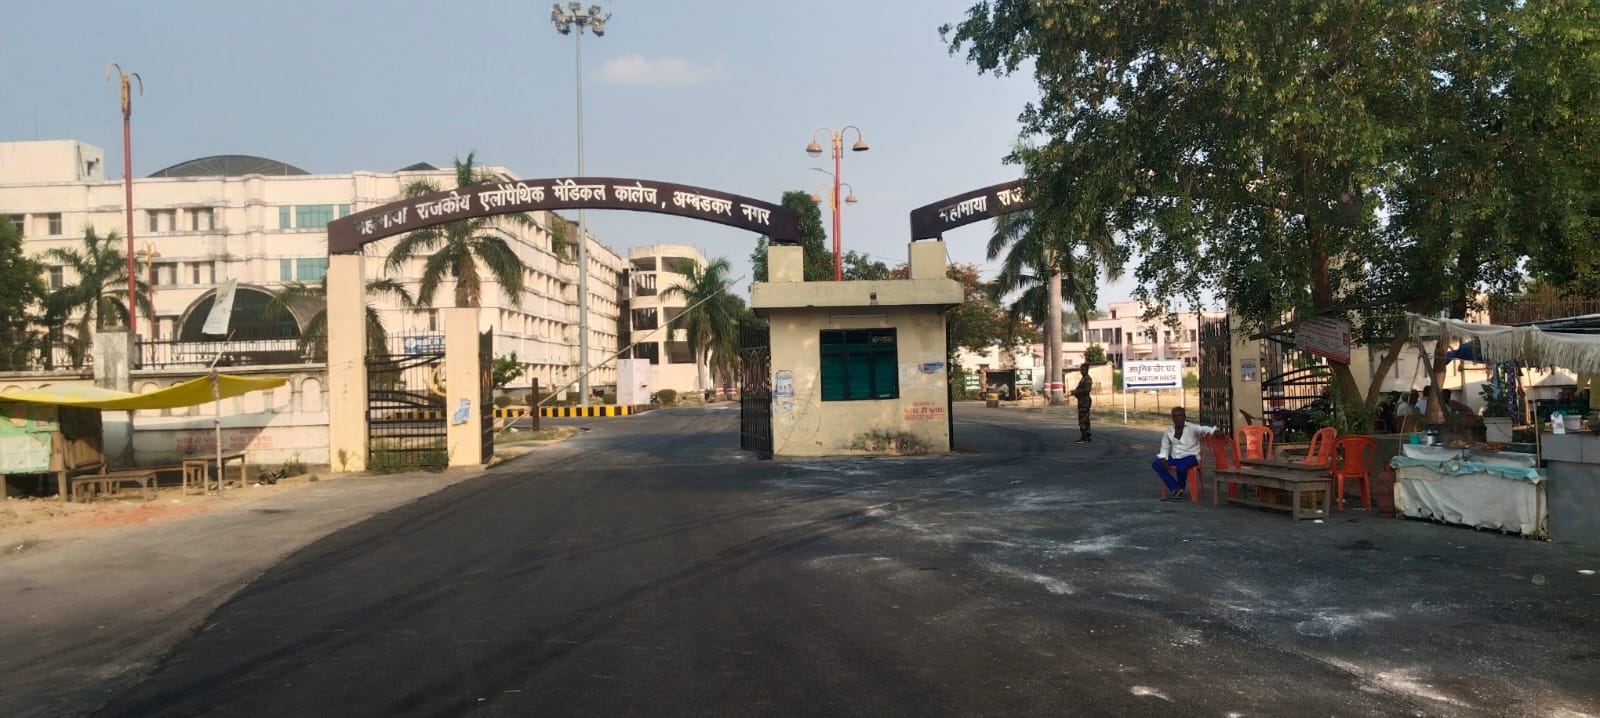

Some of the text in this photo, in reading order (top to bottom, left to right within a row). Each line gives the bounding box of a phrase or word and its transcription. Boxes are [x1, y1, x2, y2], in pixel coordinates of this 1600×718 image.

[415, 190, 471, 220] राजकीय
[477, 182, 545, 212] एलोपैथिक
[551, 179, 607, 202] मेडिकल
[739, 203, 771, 226] नगर
